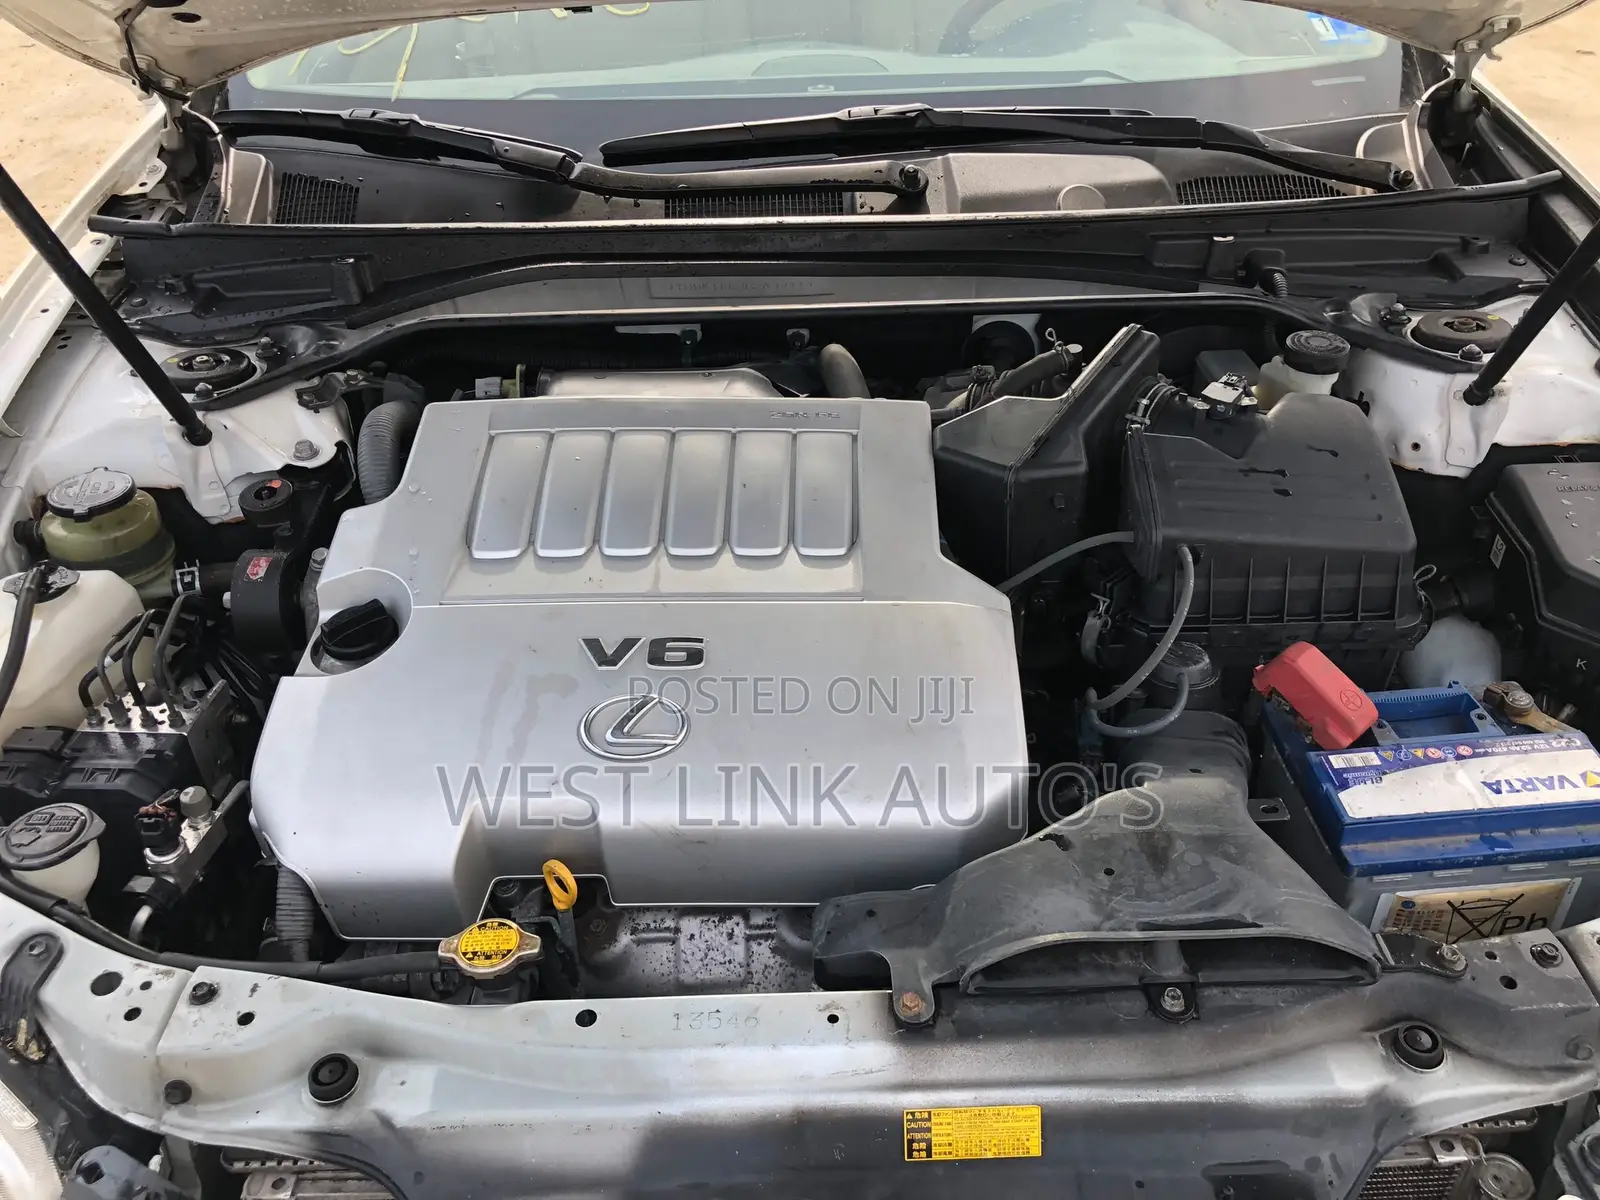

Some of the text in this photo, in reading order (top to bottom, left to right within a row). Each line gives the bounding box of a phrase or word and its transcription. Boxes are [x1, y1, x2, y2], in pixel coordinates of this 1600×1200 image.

[578, 636, 706, 670] V6
[1576, 658, 1588, 671] K
[1348, 776, 1383, 786] BLUE
[1481, 774, 1580, 794] VARTA
[1498, 912, 1548, 936] Pb
[671, 1010, 759, 1031] 13546
